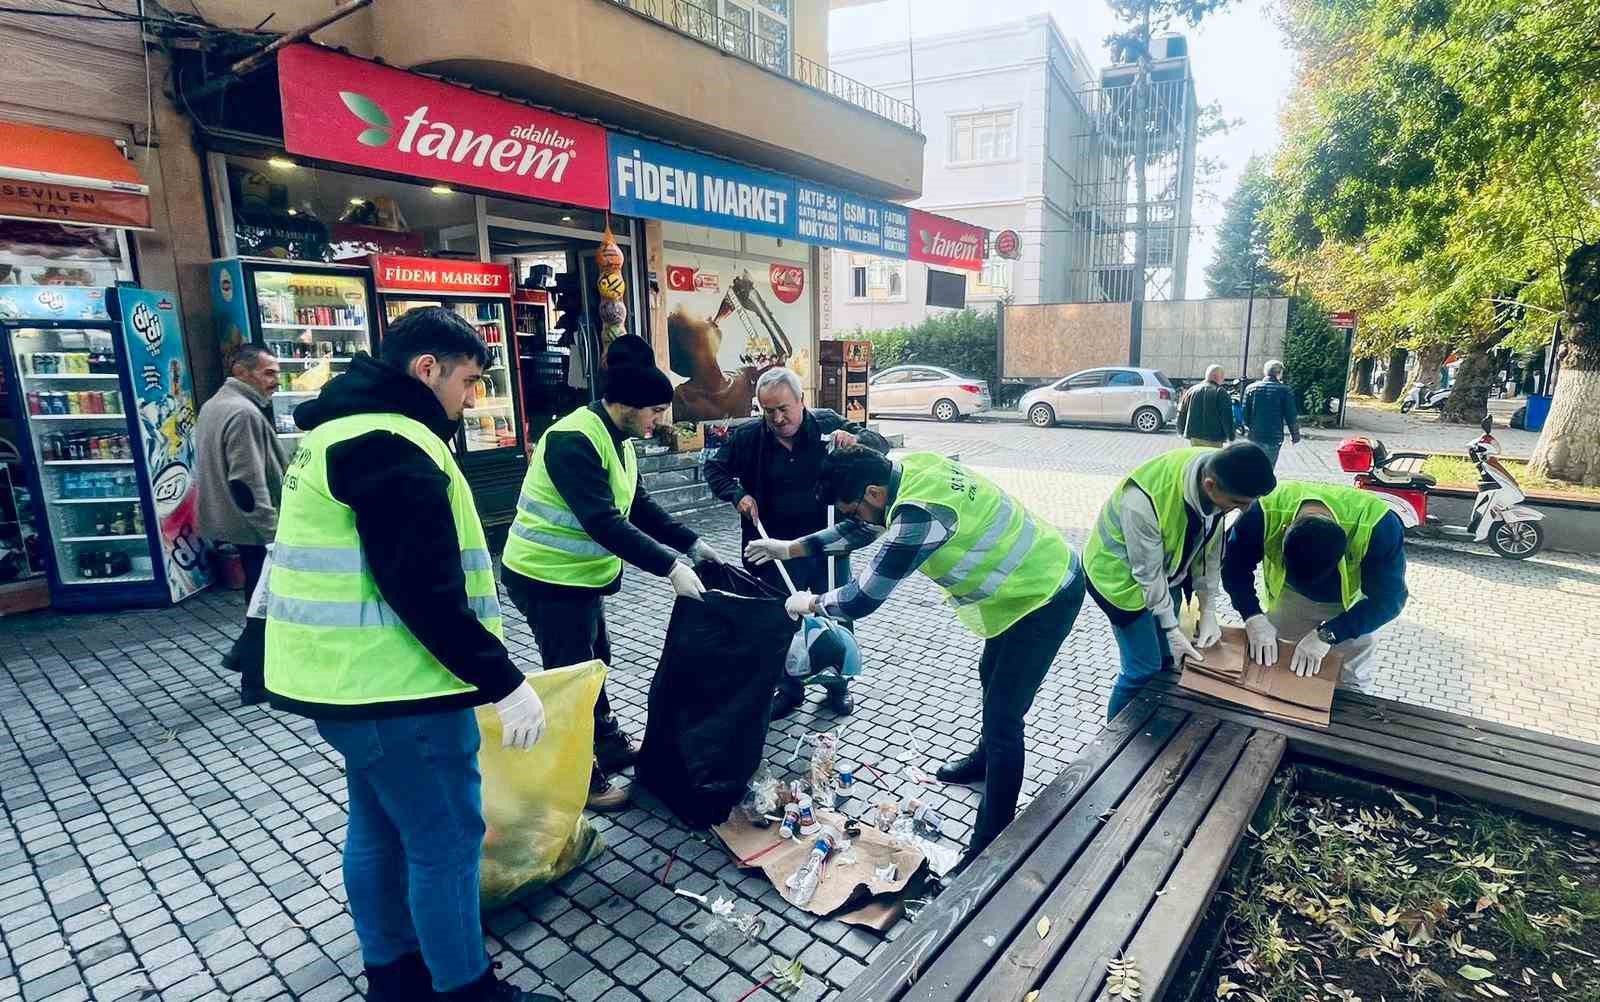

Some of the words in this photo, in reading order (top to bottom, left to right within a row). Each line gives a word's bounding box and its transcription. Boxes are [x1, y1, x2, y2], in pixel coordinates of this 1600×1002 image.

[398, 106, 570, 183] tanem
[616, 149, 698, 209] FİDEM
[703, 175, 788, 225] MARKET
[33, 200, 71, 215] TAT
[843, 202, 866, 225] GSM
[931, 232, 978, 262] tanem
[385, 265, 436, 284] FİDEM
[441, 271, 502, 287] MARKET
